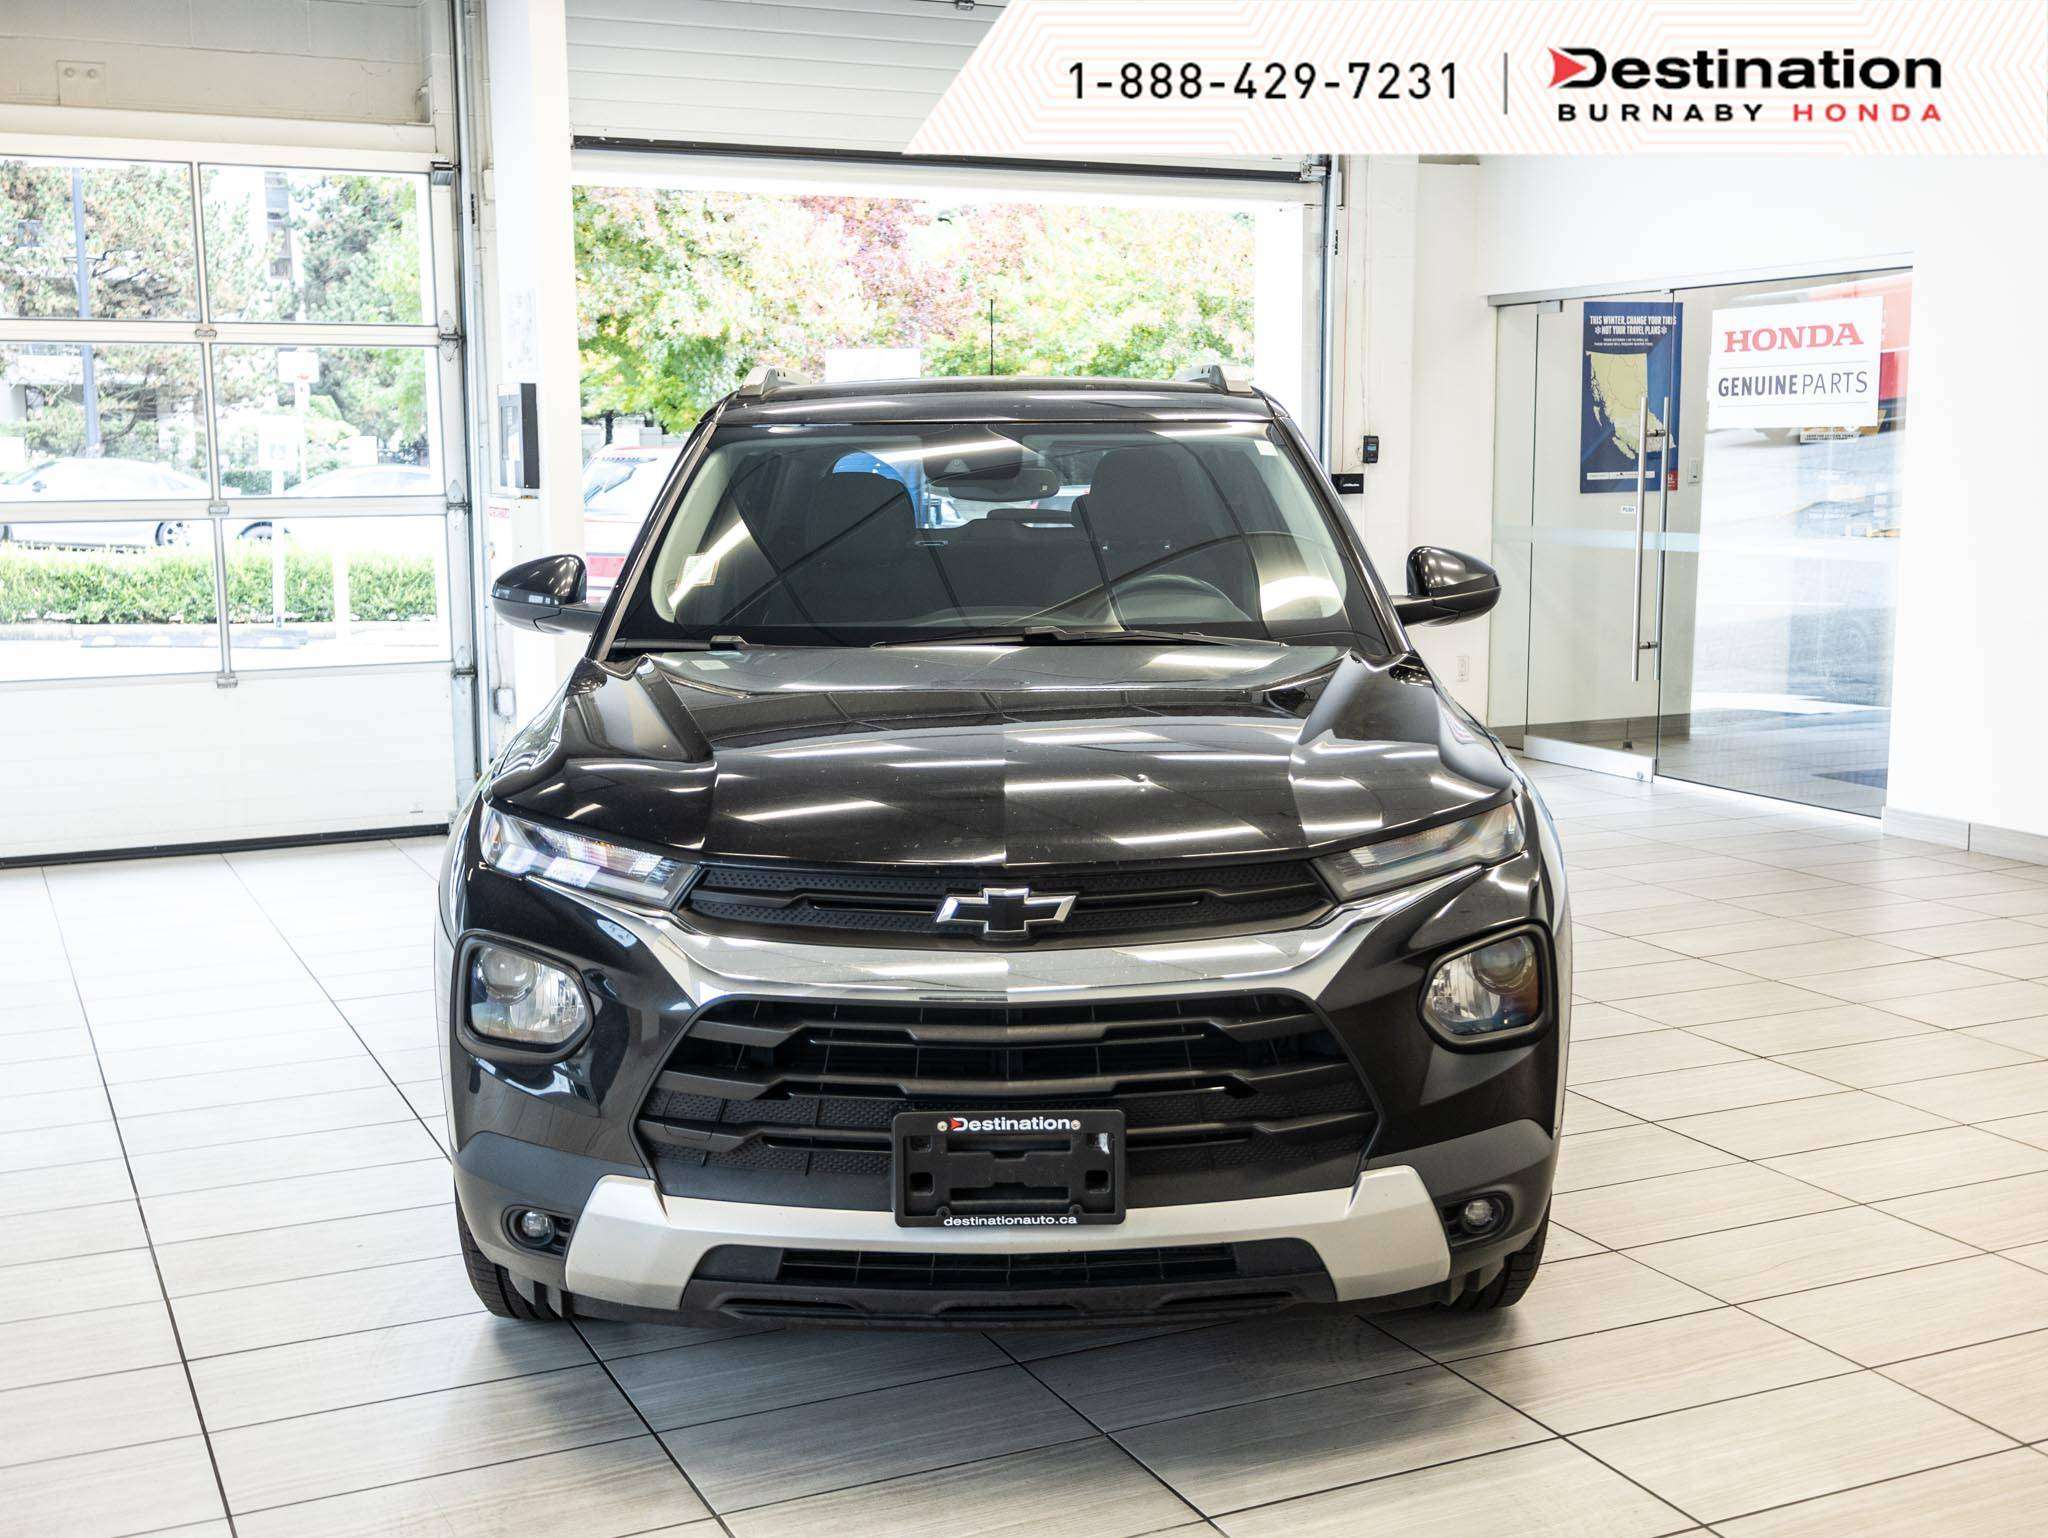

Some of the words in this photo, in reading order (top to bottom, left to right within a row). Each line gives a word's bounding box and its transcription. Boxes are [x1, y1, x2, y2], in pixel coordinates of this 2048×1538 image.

[1590, 316, 1602, 325] THIS
[1626, 316, 1647, 325] CHANGE
[1648, 316, 1662, 325] YOUR
[1602, 326, 1612, 335] NOT
[1612, 326, 1626, 335] YOUR
[1627, 326, 1645, 335] TRAVEL
[1645, 326, 1660, 335] PLANS
[1724, 322, 1864, 352] HONDA
[1718, 375, 1798, 397] GENUINE
[1802, 371, 1868, 395] PARTS
[951, 1116, 1071, 1131] Destination
[943, 1215, 1078, 1227] destinationauto.ca
